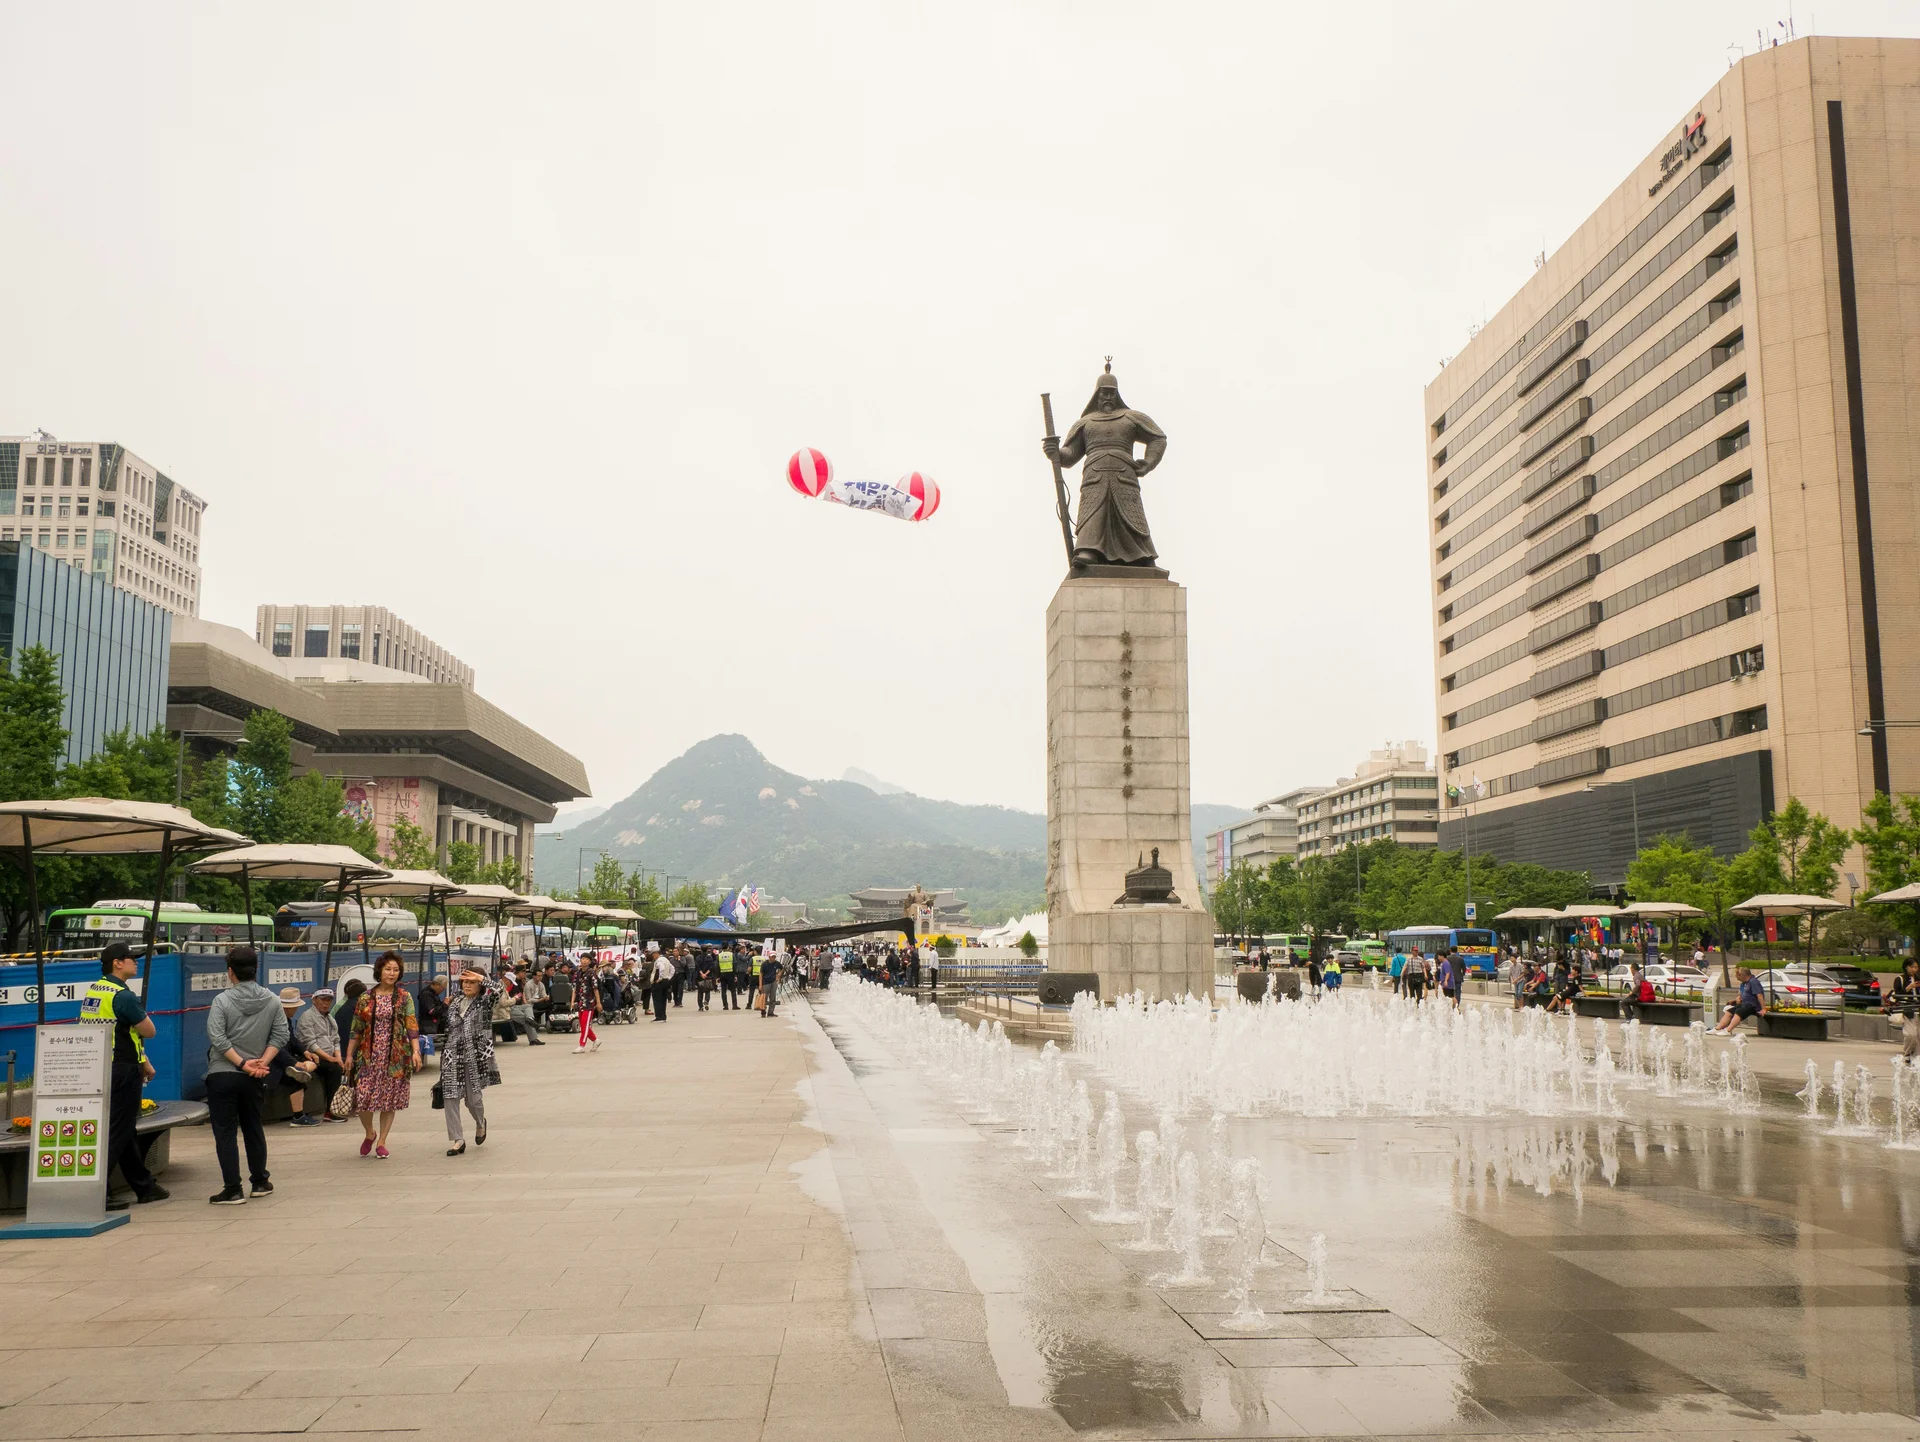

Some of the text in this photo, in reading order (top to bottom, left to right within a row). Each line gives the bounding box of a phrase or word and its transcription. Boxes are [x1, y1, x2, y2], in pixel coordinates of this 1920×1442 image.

[36, 443, 92, 456] 외교부 MOFA
[55, 1105, 84, 1114] 이용안내
